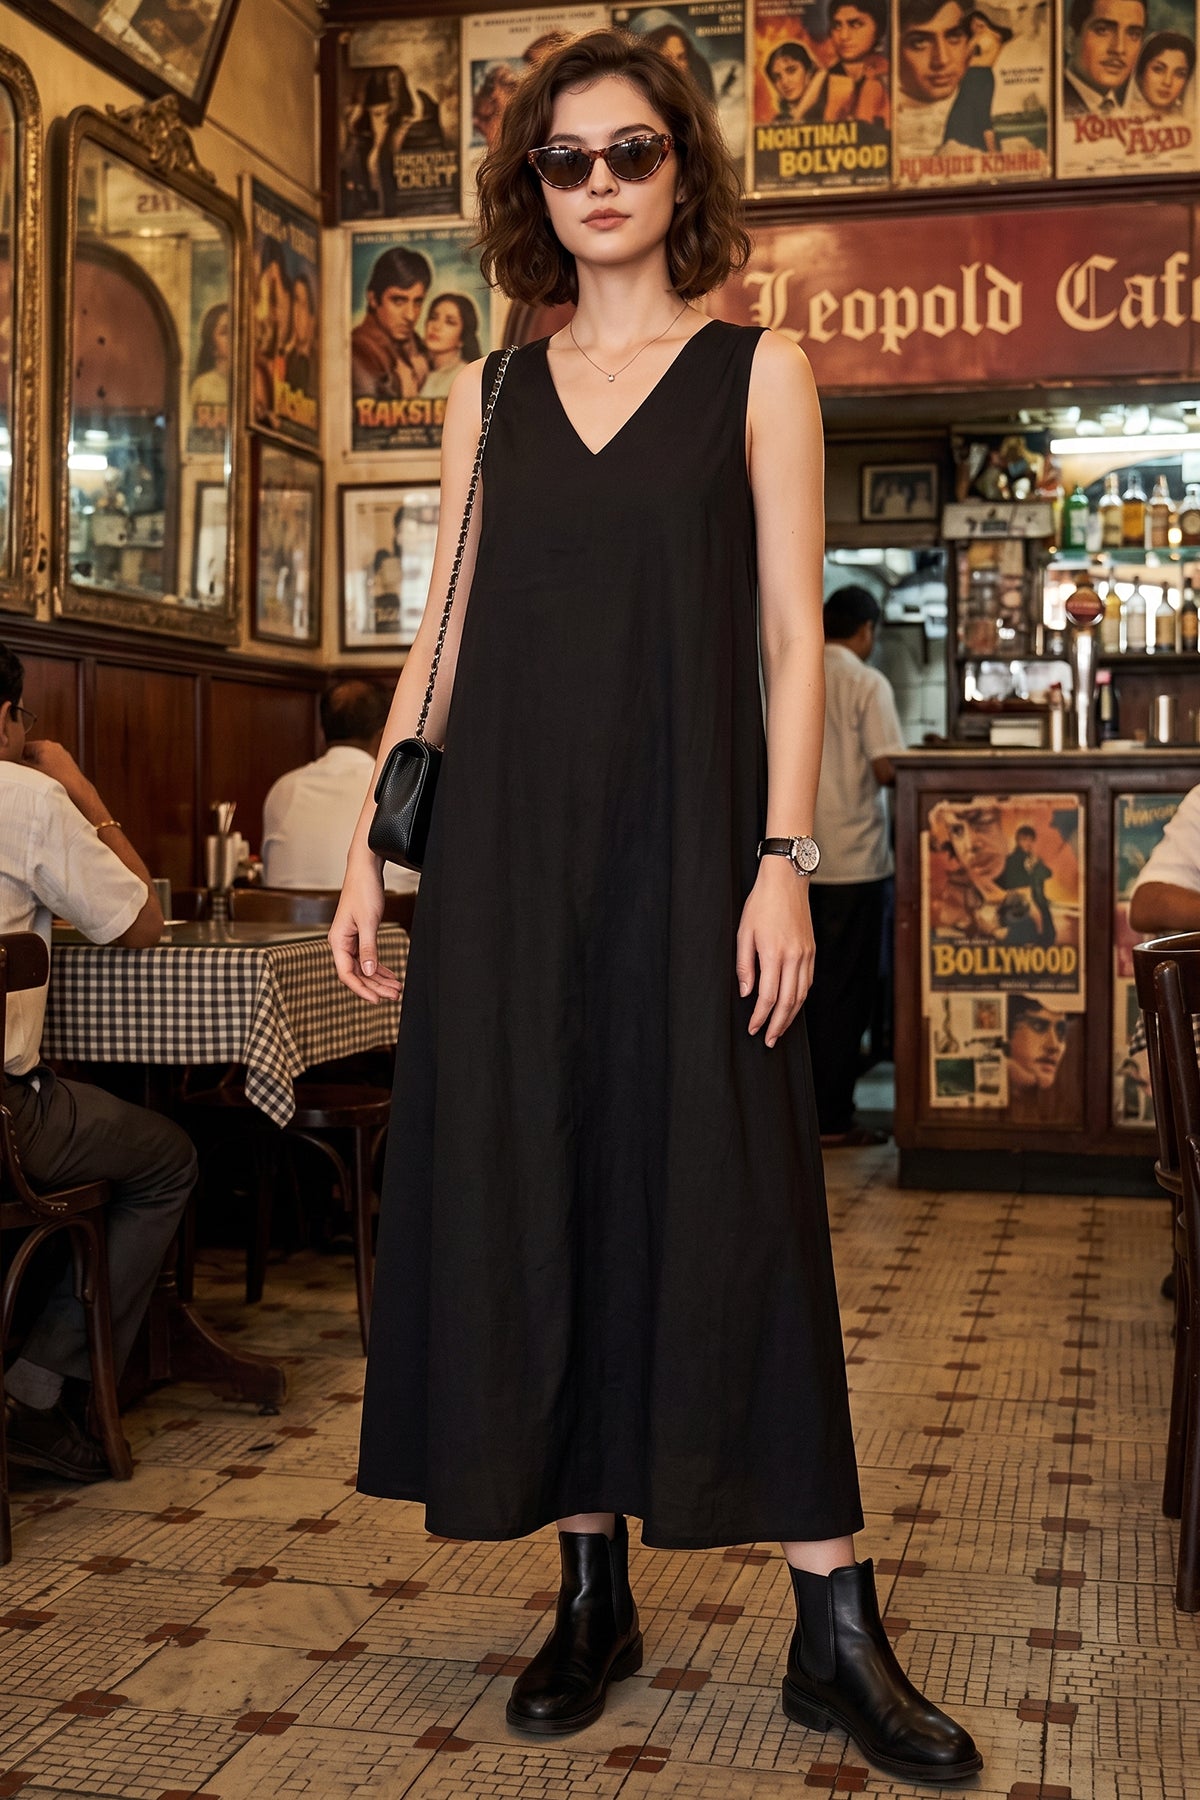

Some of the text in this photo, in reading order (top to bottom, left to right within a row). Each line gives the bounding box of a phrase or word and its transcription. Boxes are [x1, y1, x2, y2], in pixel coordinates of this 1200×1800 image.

[779, 144, 888, 177] BOLYOOD
[742, 262, 1023, 355] Leopold
[932, 943, 1077, 977] BOLLYWOOD
